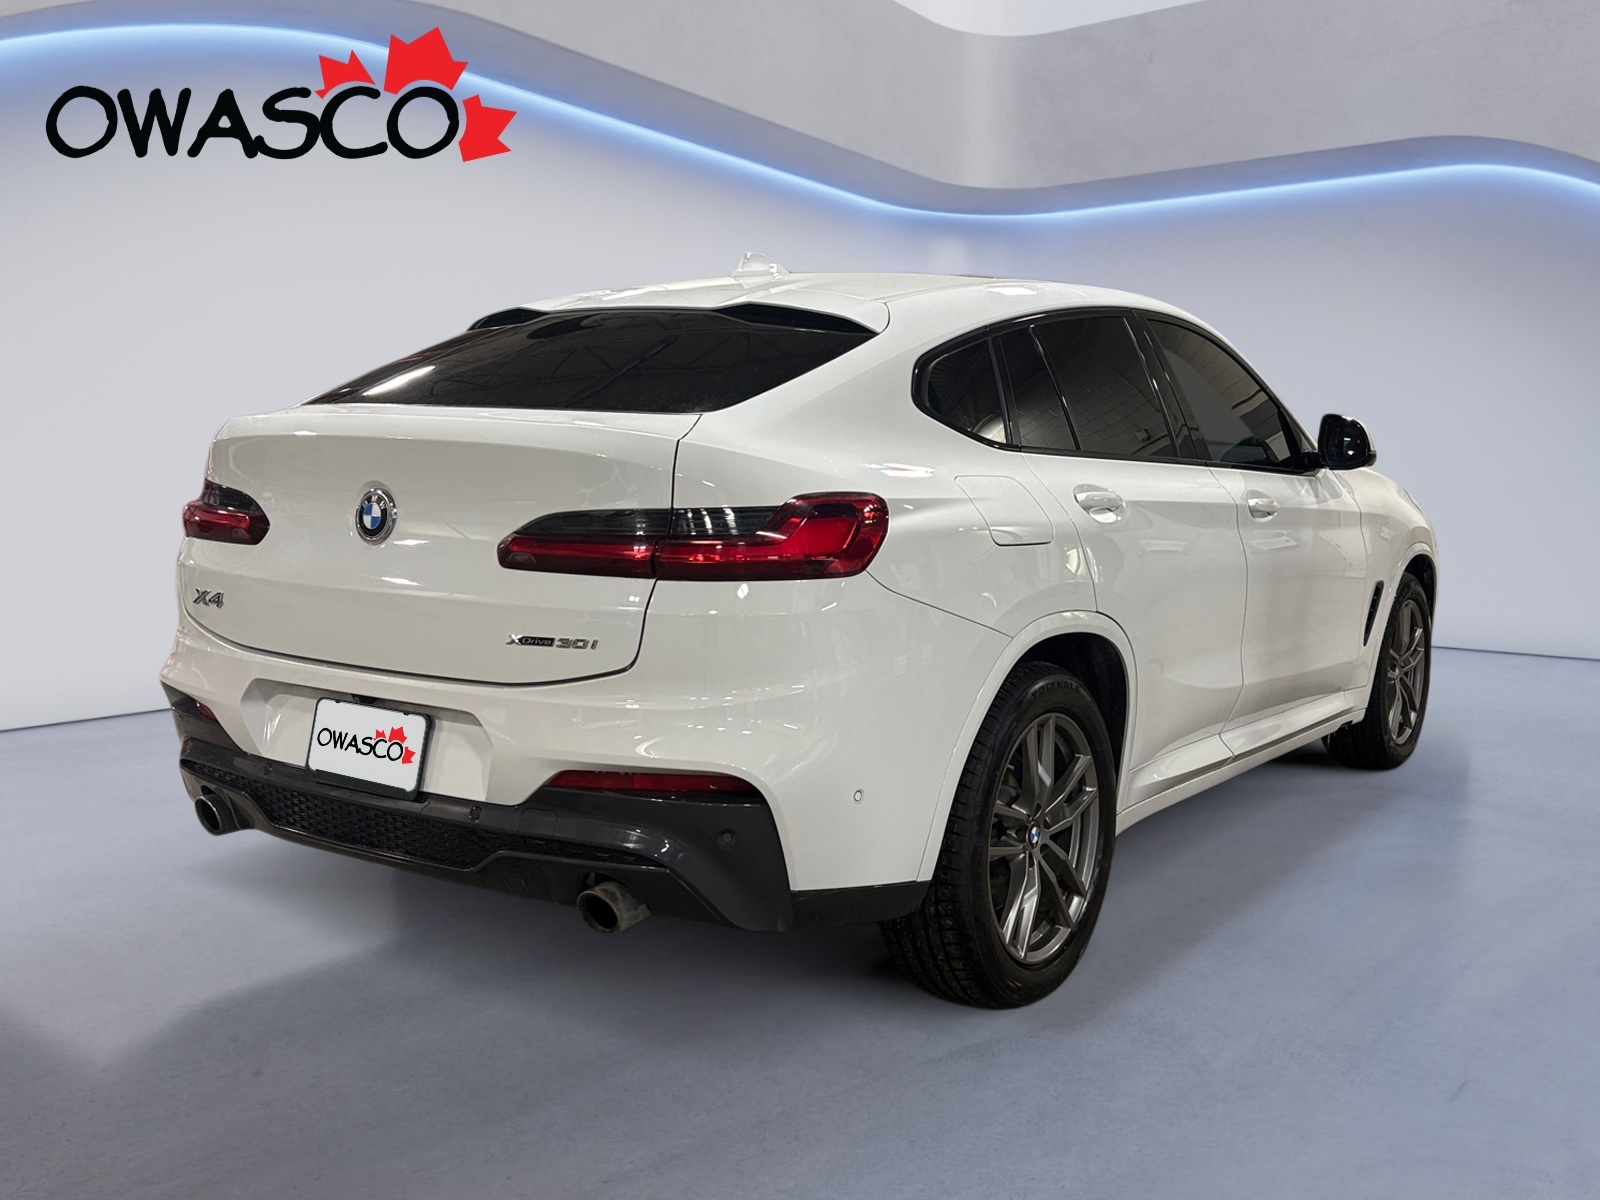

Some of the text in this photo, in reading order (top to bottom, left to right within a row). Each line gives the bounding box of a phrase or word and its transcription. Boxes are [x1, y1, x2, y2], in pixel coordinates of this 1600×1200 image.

[361, 494, 388, 510] BMW
[192, 588, 224, 609] X4
[1031, 680, 1082, 701] TRIANGLE
